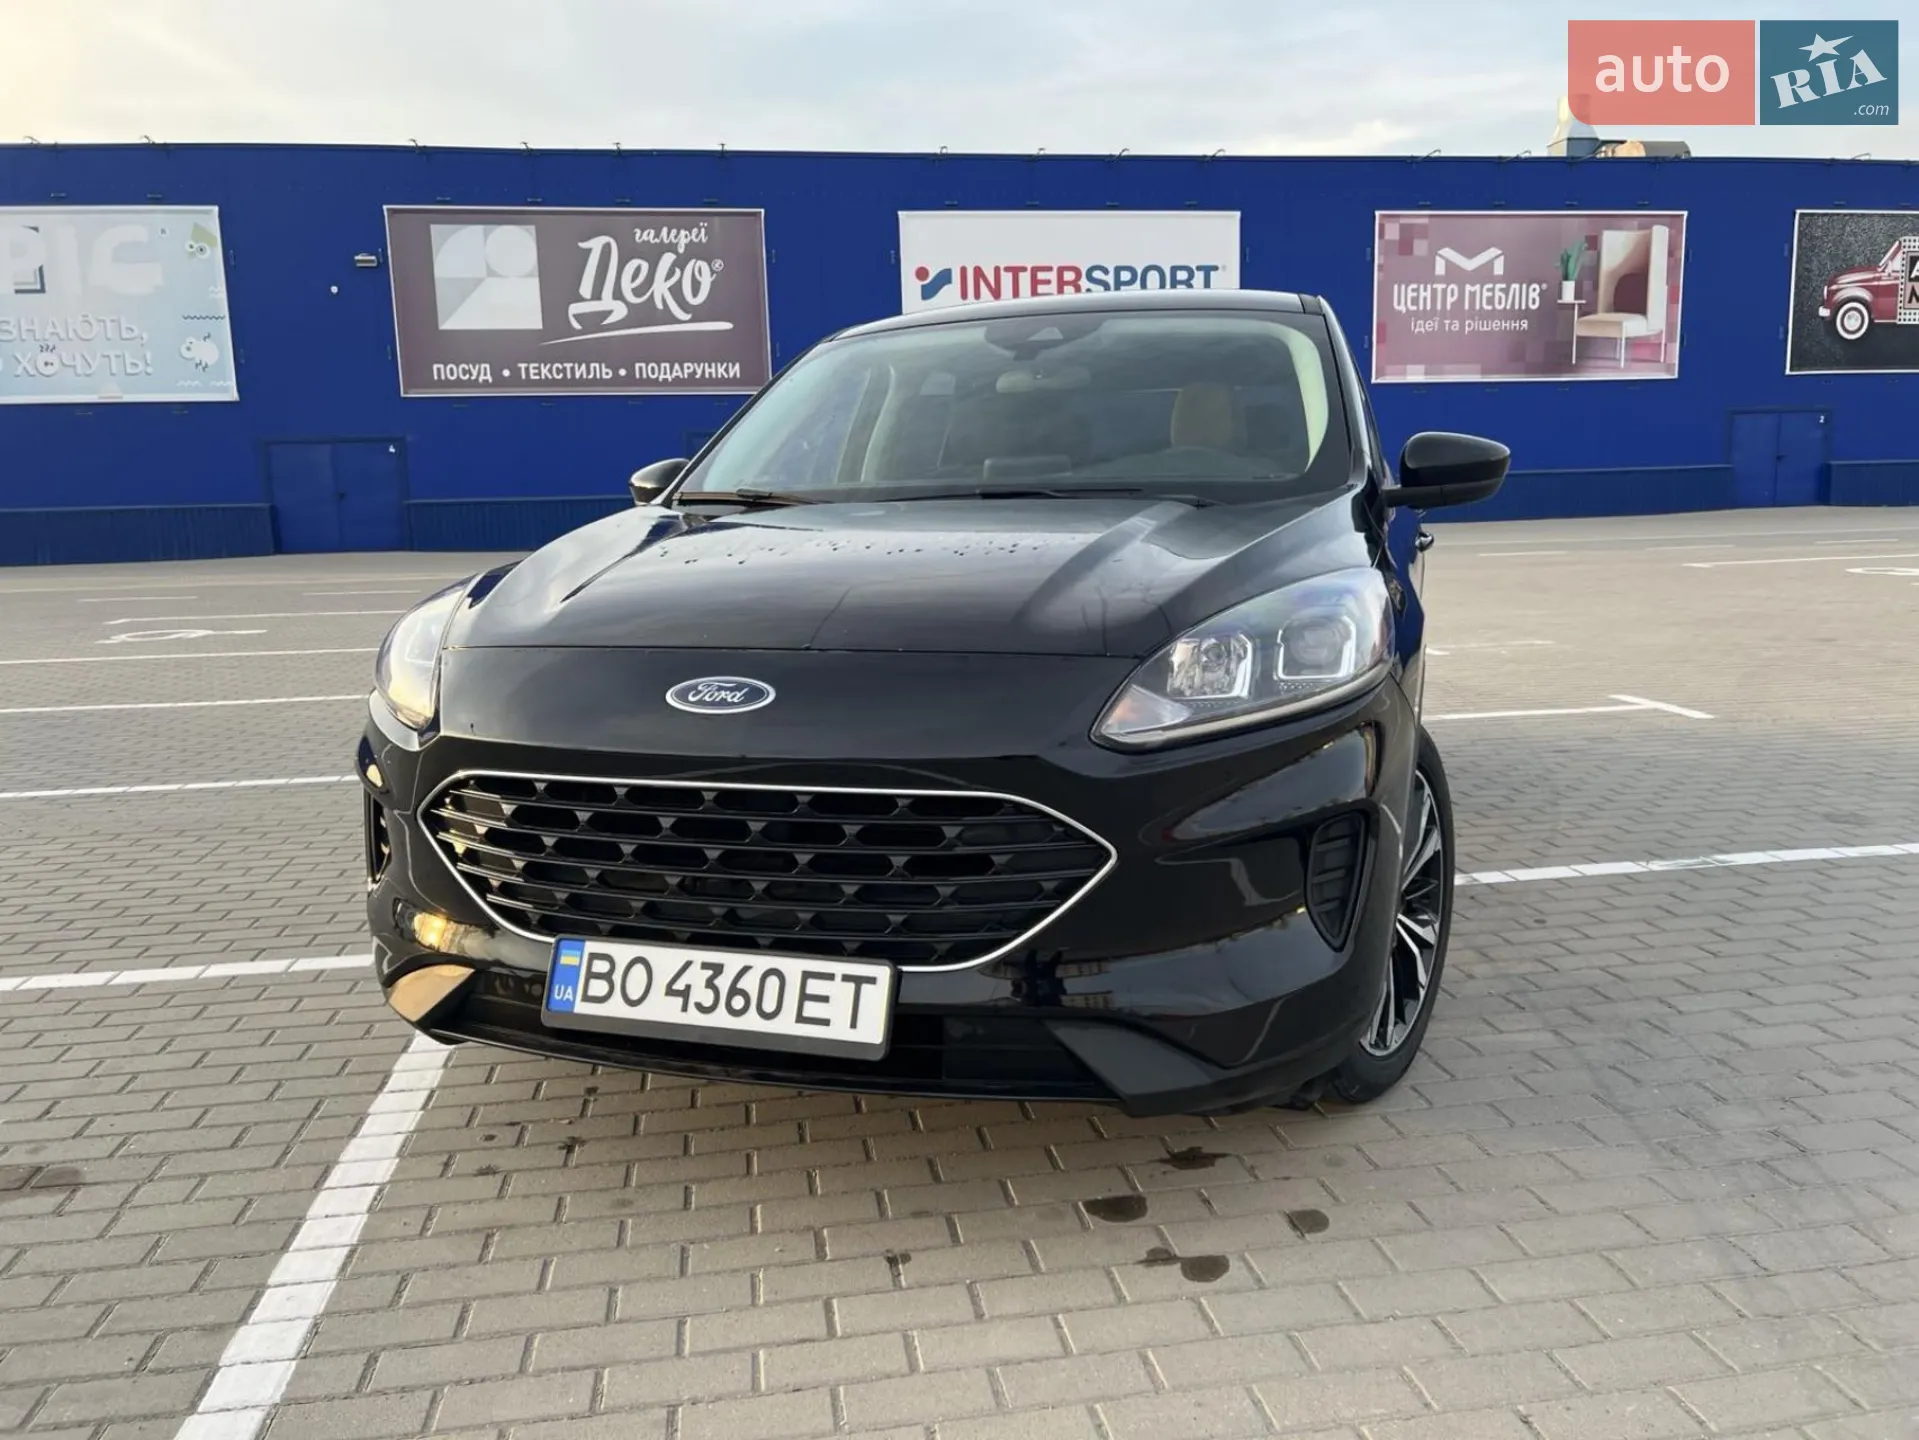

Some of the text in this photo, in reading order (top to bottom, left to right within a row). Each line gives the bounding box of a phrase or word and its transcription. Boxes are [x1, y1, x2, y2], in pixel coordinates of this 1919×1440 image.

[959, 264, 1220, 301] INTERSPORT
[1393, 282, 1459, 313] ЦЕНТР
[1411, 316, 1528, 335] ідеї та рішення
[12, 348, 154, 377] ХОЧУТЬ!
[432, 361, 741, 383] ПОСУД ТЕКСТИЛЬ ПОДАРУНКИ
[688, 681, 748, 705] Ford
[554, 984, 574, 1001] UA
